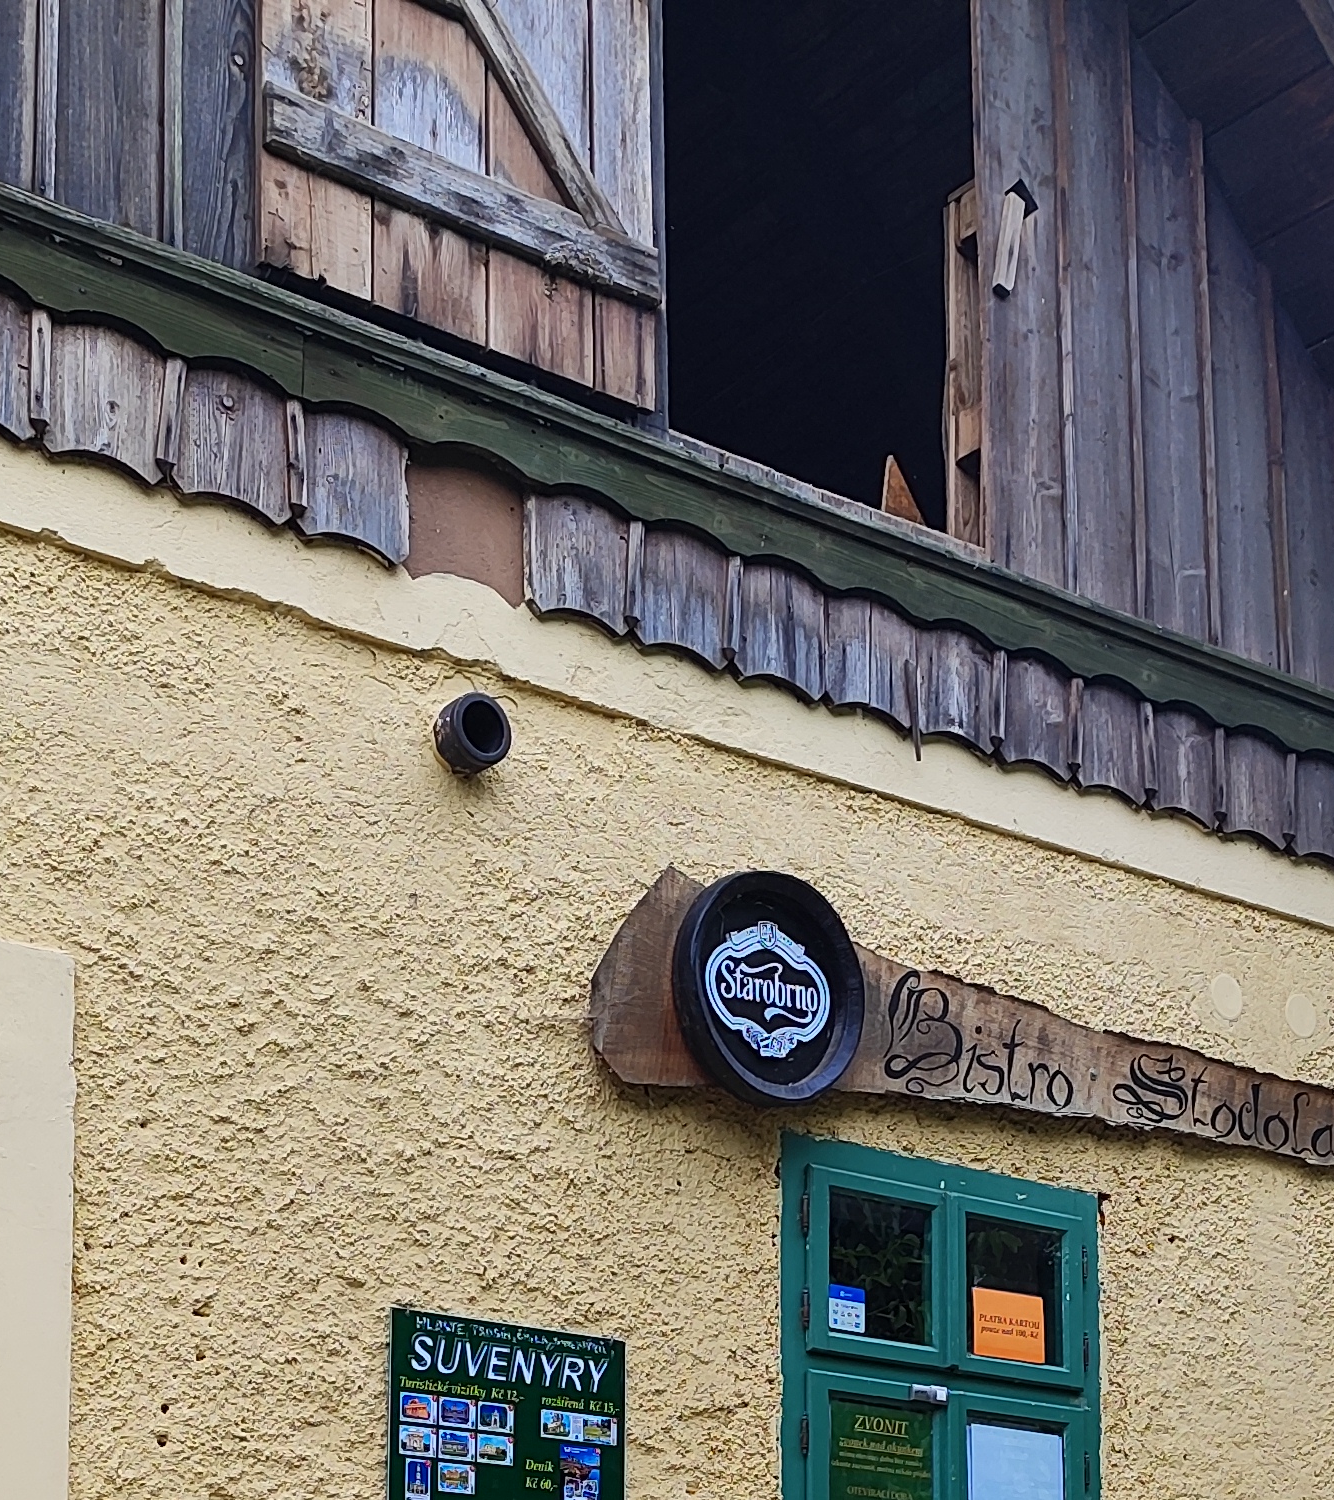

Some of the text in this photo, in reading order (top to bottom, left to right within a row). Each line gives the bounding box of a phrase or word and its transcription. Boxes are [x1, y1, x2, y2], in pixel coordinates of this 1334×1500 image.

[720, 960, 818, 1023] Starobrno
[884, 970, 1074, 1111] Bistro
[410, 1335, 608, 1394] SUVENYRY
[399, 1375, 449, 1393] Turistické
[491, 1387, 505, 1399] Kč
[589, 1400, 602, 1412] Kč
[853, 1414, 909, 1436] ZVONIT
[525, 1476, 539, 1489] Kč
